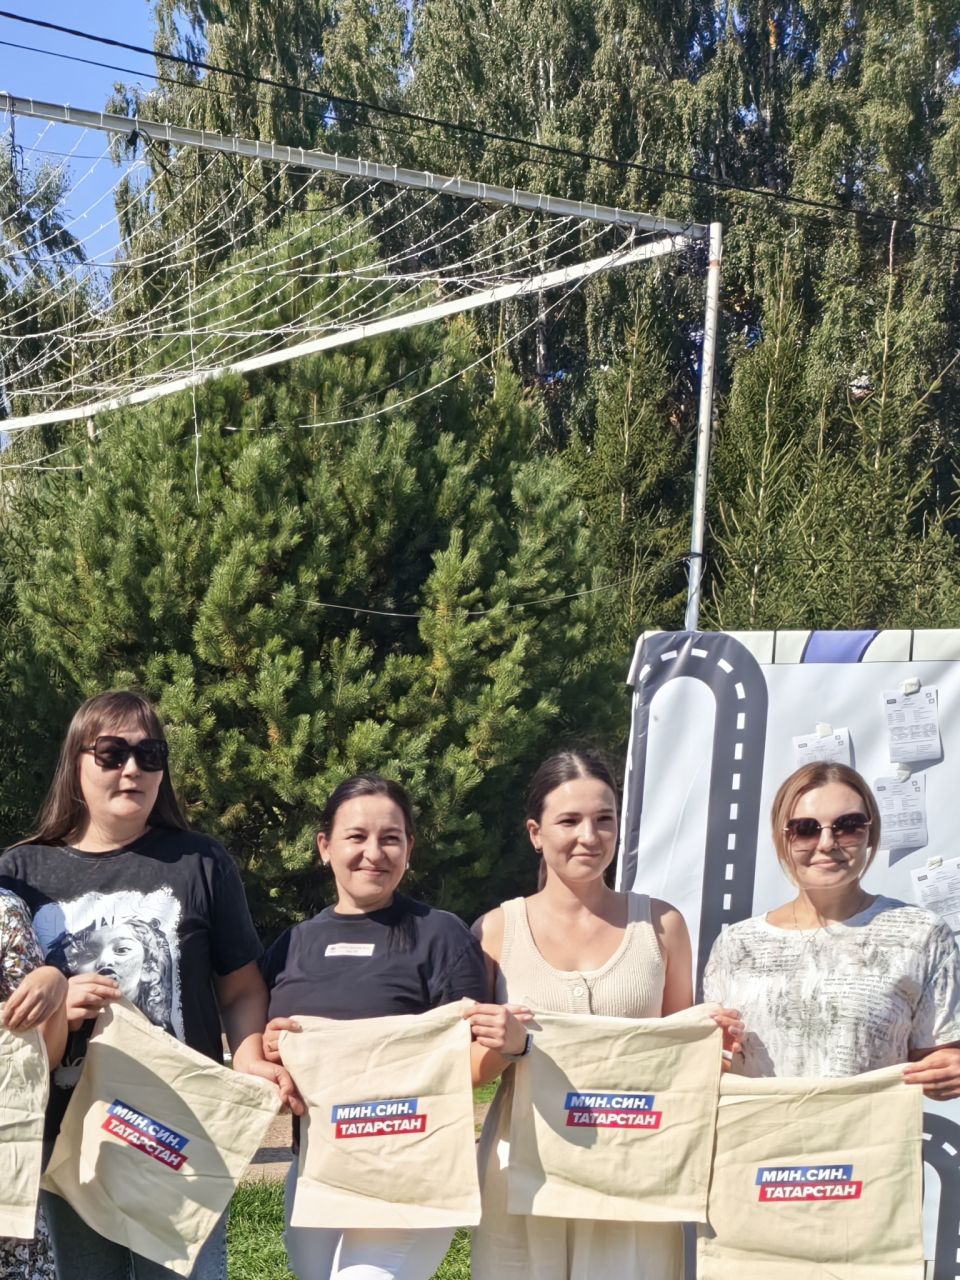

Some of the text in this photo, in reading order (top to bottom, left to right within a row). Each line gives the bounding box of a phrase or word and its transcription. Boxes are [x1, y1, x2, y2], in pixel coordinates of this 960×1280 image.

[571, 1095, 649, 1109] МИН.СИН.
[336, 1102, 413, 1120] МИН.СИН.
[573, 1112, 657, 1126] ТАТАРСТАН
[113, 1105, 180, 1149] МИН.СИН.
[340, 1118, 422, 1135] ТАТАРСТАН
[108, 1119, 181, 1166] ТАТАРСТАН
[761, 1168, 847, 1183] МИН.СИН.
[765, 1184, 857, 1199] ТАТАРСТАН
